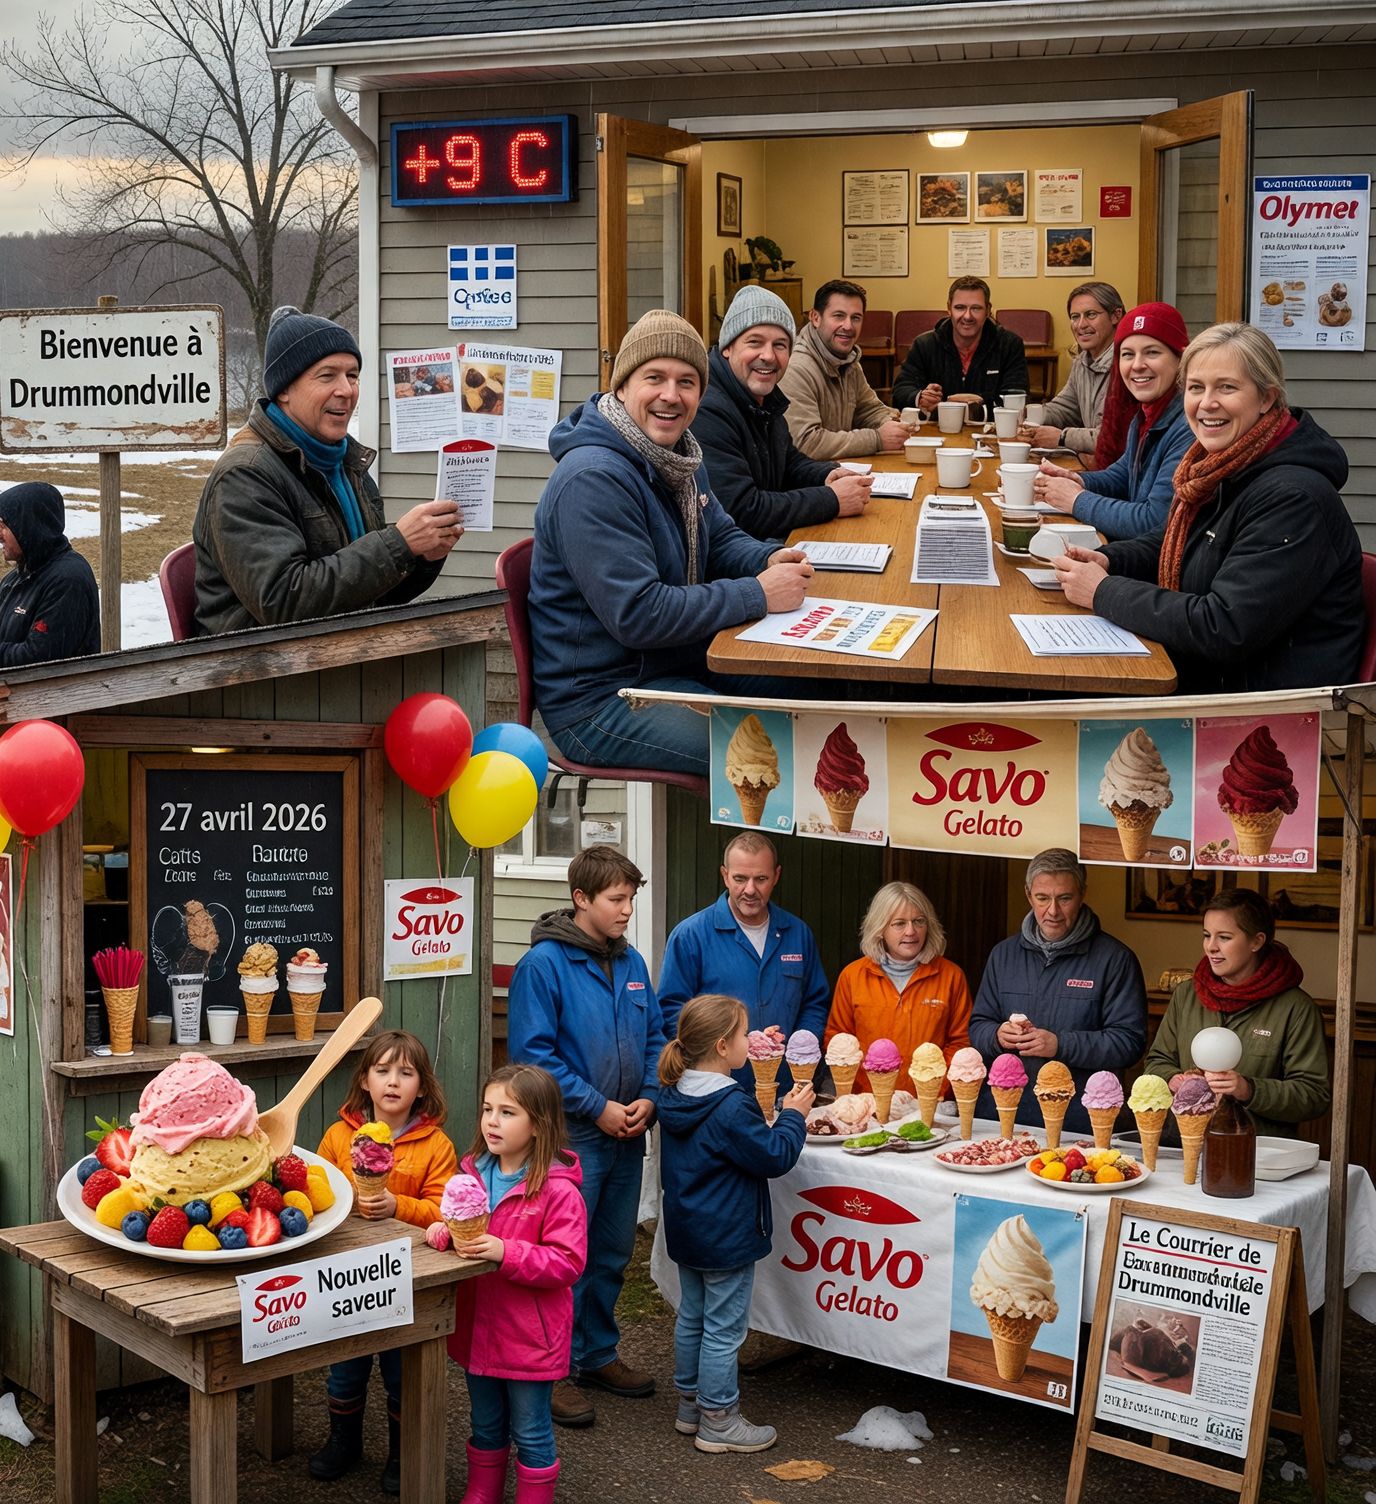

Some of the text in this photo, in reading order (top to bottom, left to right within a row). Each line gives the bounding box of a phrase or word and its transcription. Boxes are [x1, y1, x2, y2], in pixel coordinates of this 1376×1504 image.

[405, 132, 548, 189] +9 C
[40, 325, 203, 359] Bienvenue à
[10, 372, 211, 408] Drummondville
[912, 749, 1046, 807] Savo
[159, 801, 327, 832] 27 avril 2026
[943, 809, 1023, 838] Gelato
[392, 905, 464, 941] Savo
[781, 1211, 924, 1290] Savo
[1129, 1222, 1261, 1265] Le Courrier de
[317, 1252, 402, 1293] Nouvelle
[252, 1291, 307, 1323] Savo
[332, 1287, 397, 1318] saveur
[815, 1280, 899, 1322] Gelato
[1118, 1270, 1251, 1316] Drummondville
